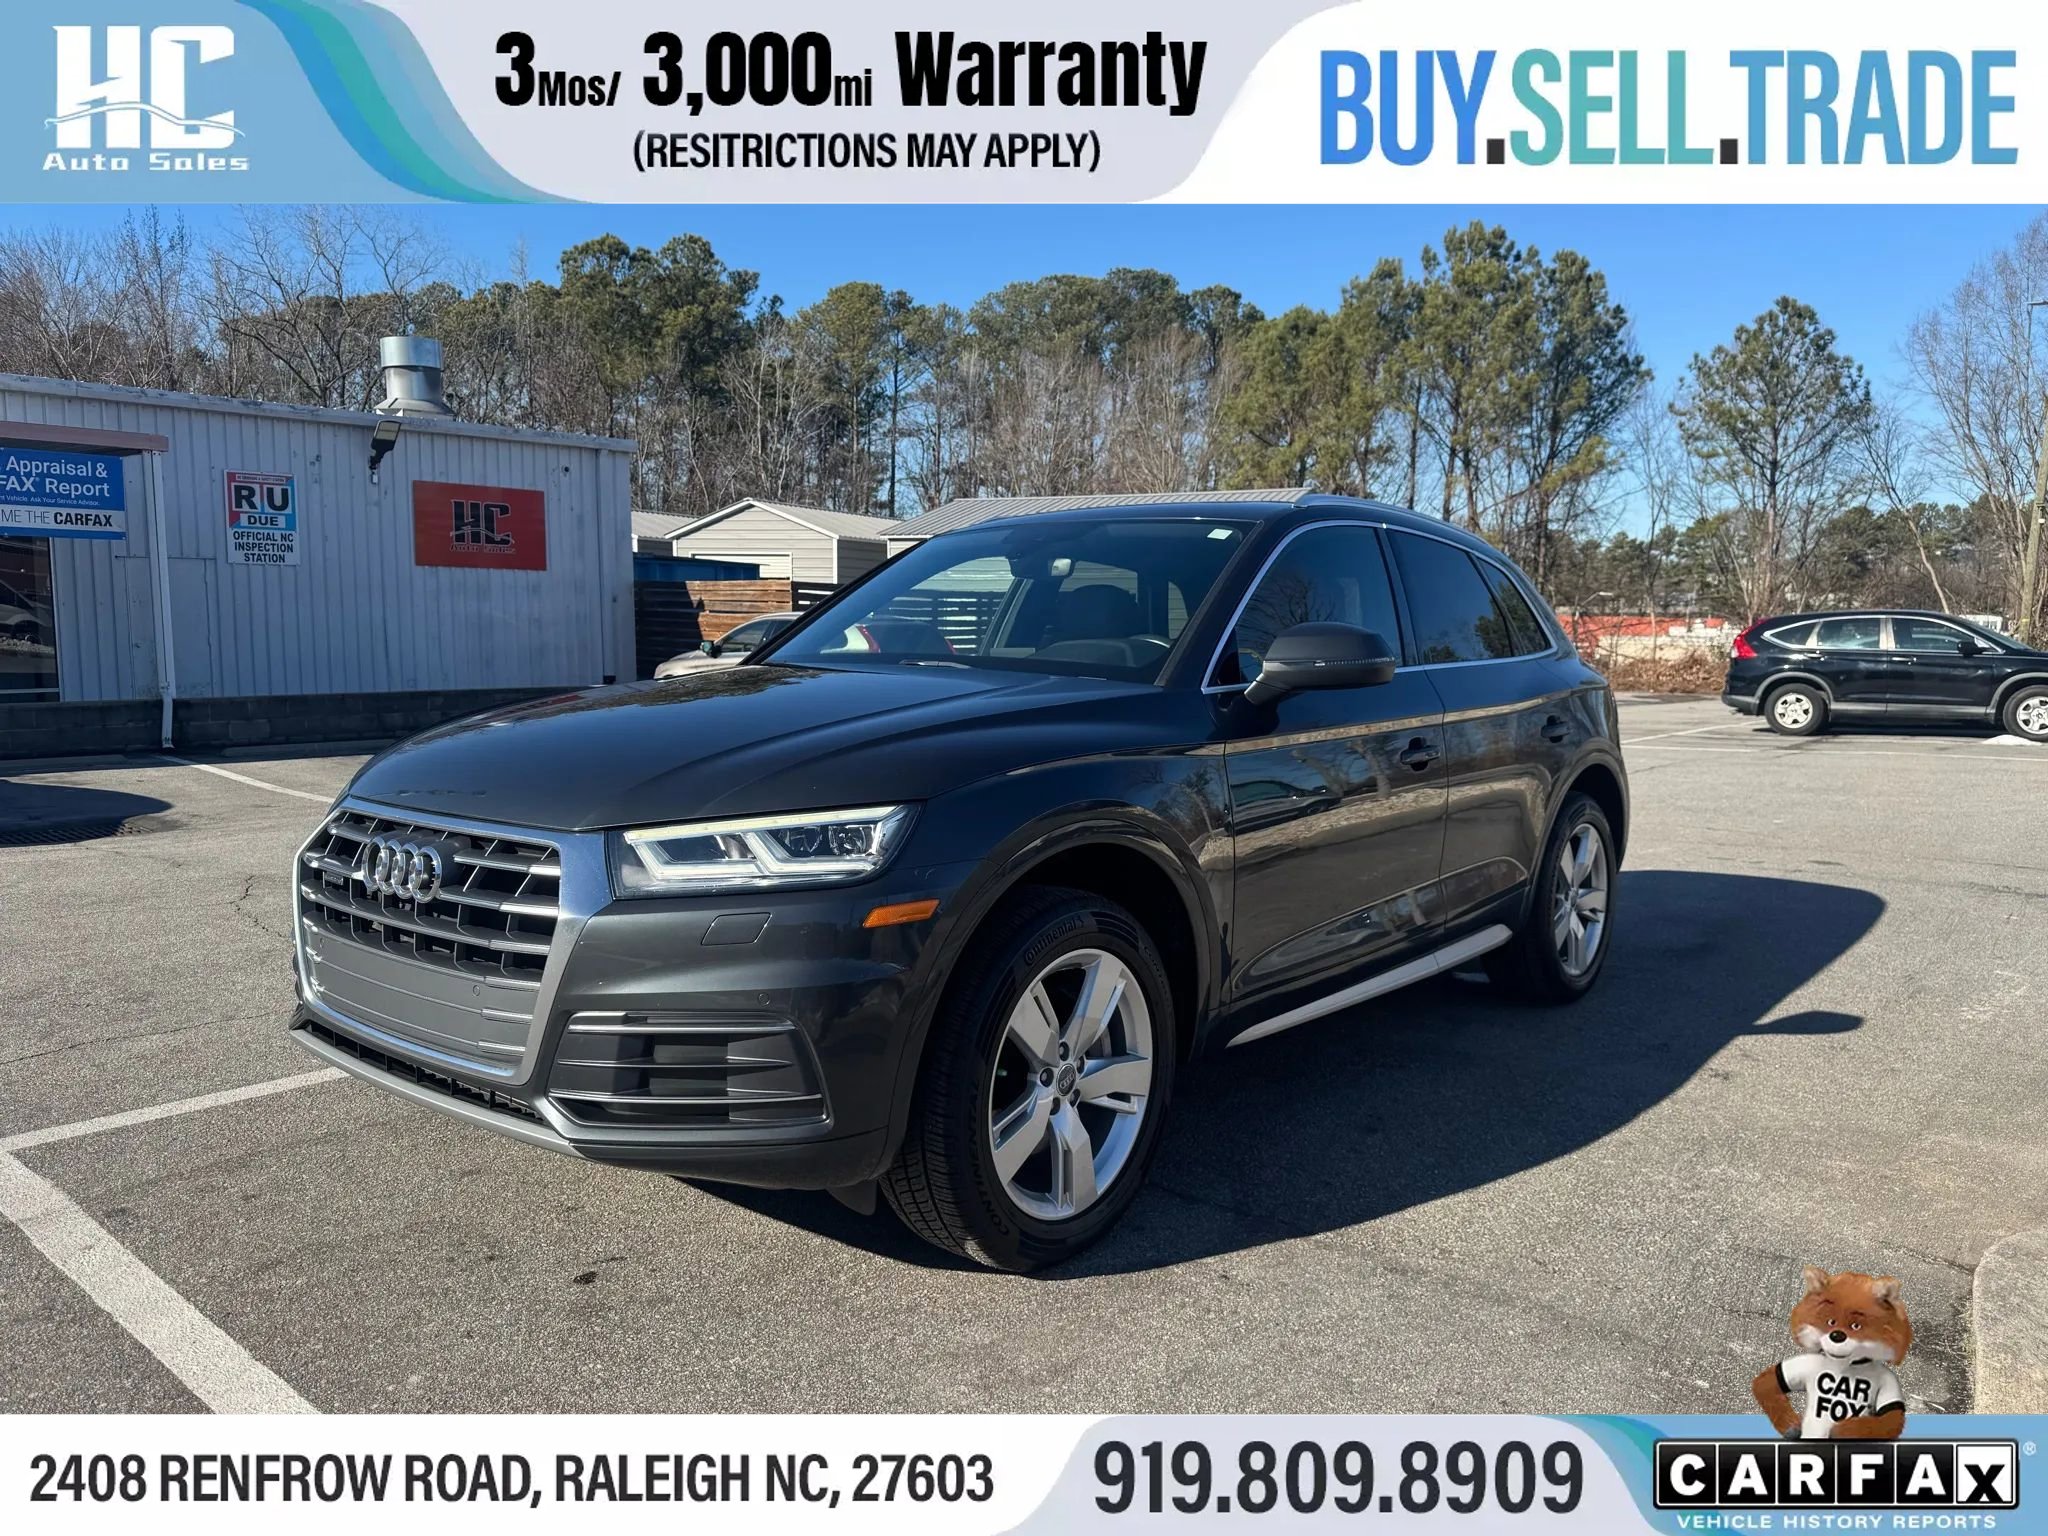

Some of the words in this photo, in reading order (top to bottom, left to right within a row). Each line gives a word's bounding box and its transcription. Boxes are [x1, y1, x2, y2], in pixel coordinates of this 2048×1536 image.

[6, 455, 92, 477] Appraisal
[95, 462, 108, 478] &
[45, 477, 110, 499] Report
[57, 497, 77, 505] Service
[1, 509, 21, 523] ME
[25, 510, 50, 525] THE
[53, 511, 113, 527] CARFAX
[247, 514, 279, 526] DUE
[450, 499, 512, 546] HC
[233, 530, 278, 542] OFFICIAL
[280, 532, 294, 543] NC
[234, 541, 294, 553] INSPECTION
[244, 552, 286, 563] STATION
